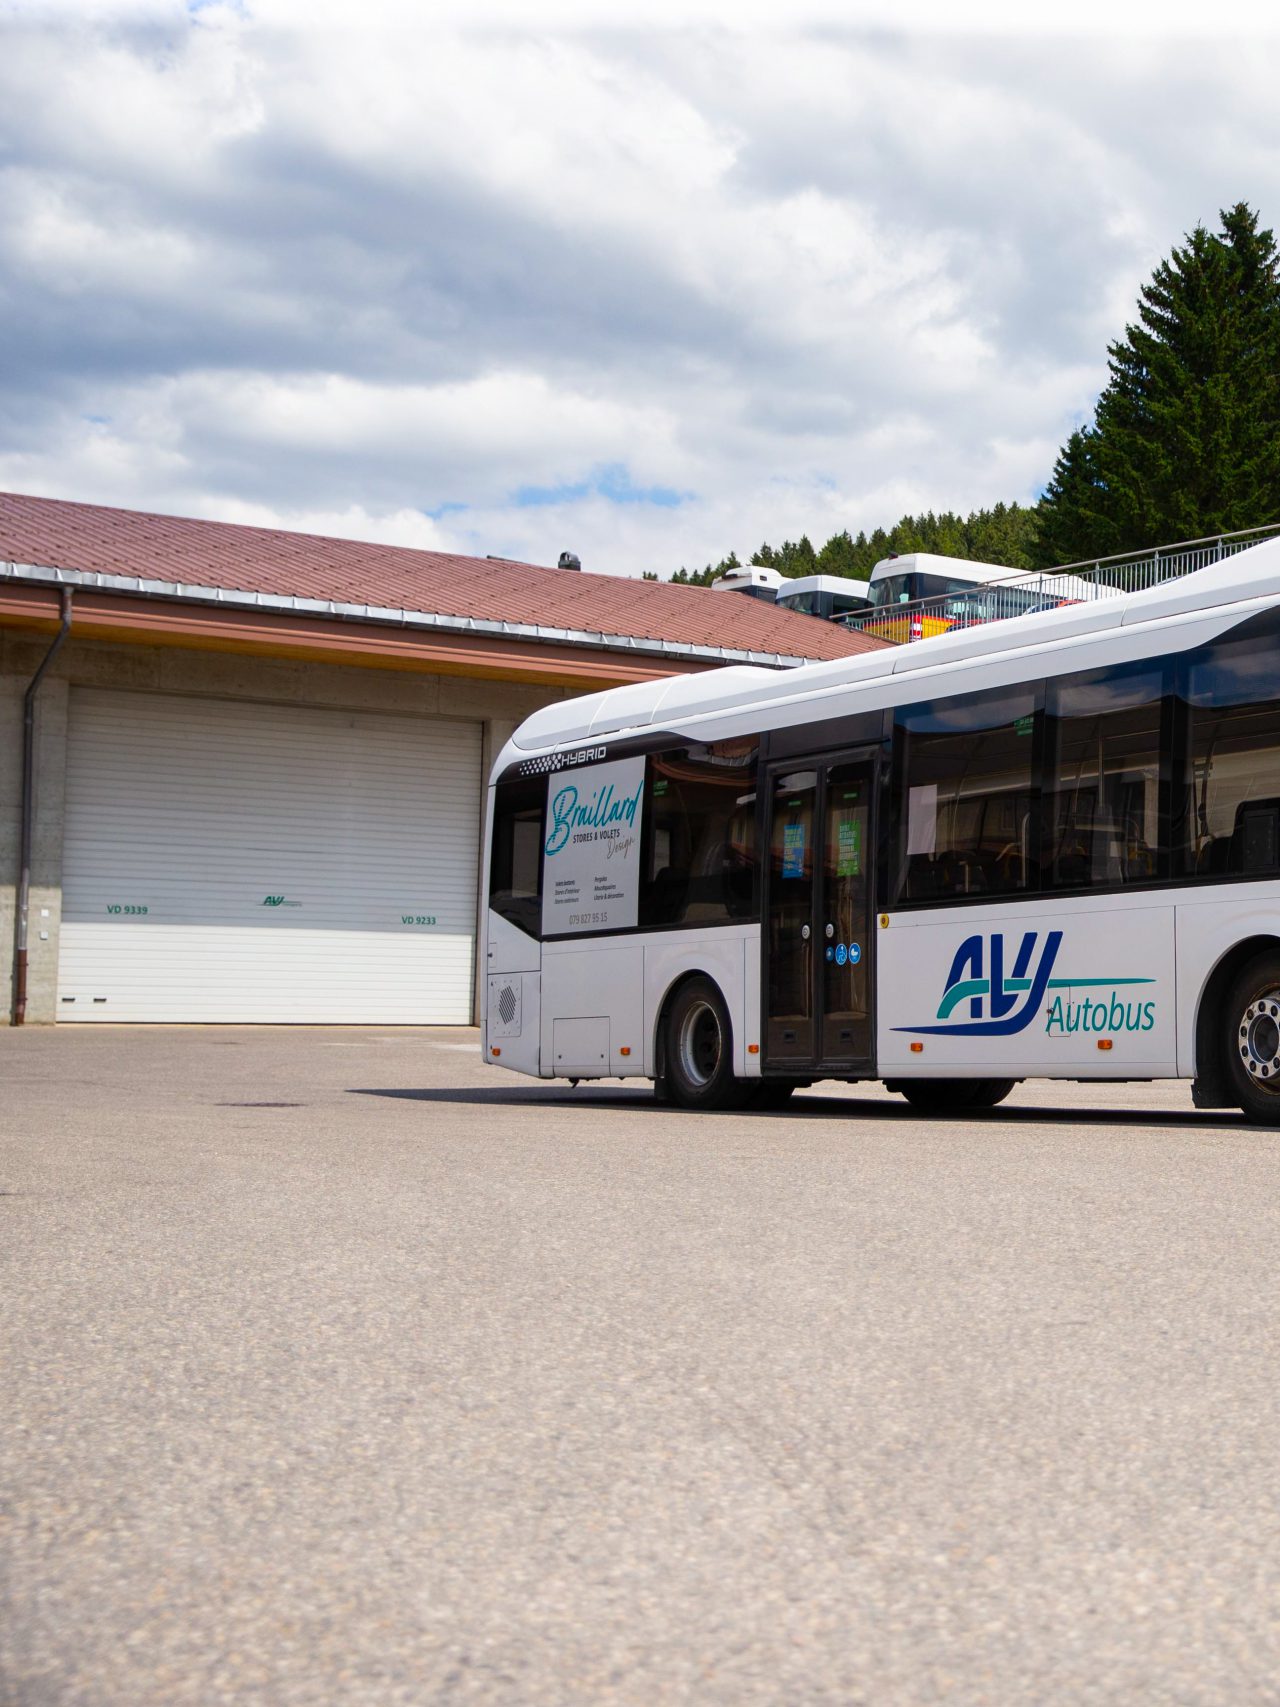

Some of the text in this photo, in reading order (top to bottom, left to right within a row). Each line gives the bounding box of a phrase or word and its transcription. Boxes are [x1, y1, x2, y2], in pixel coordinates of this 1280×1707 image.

[561, 747, 606, 767] HYBRID
[544, 779, 644, 856] Braillard
[573, 828, 621, 844] STORES & VOLETS
[607, 836, 635, 859] Design
[106, 905, 148, 915] VD 9339
[401, 916, 437, 925] VD 9233
[1046, 992, 1156, 1032] Autobus
